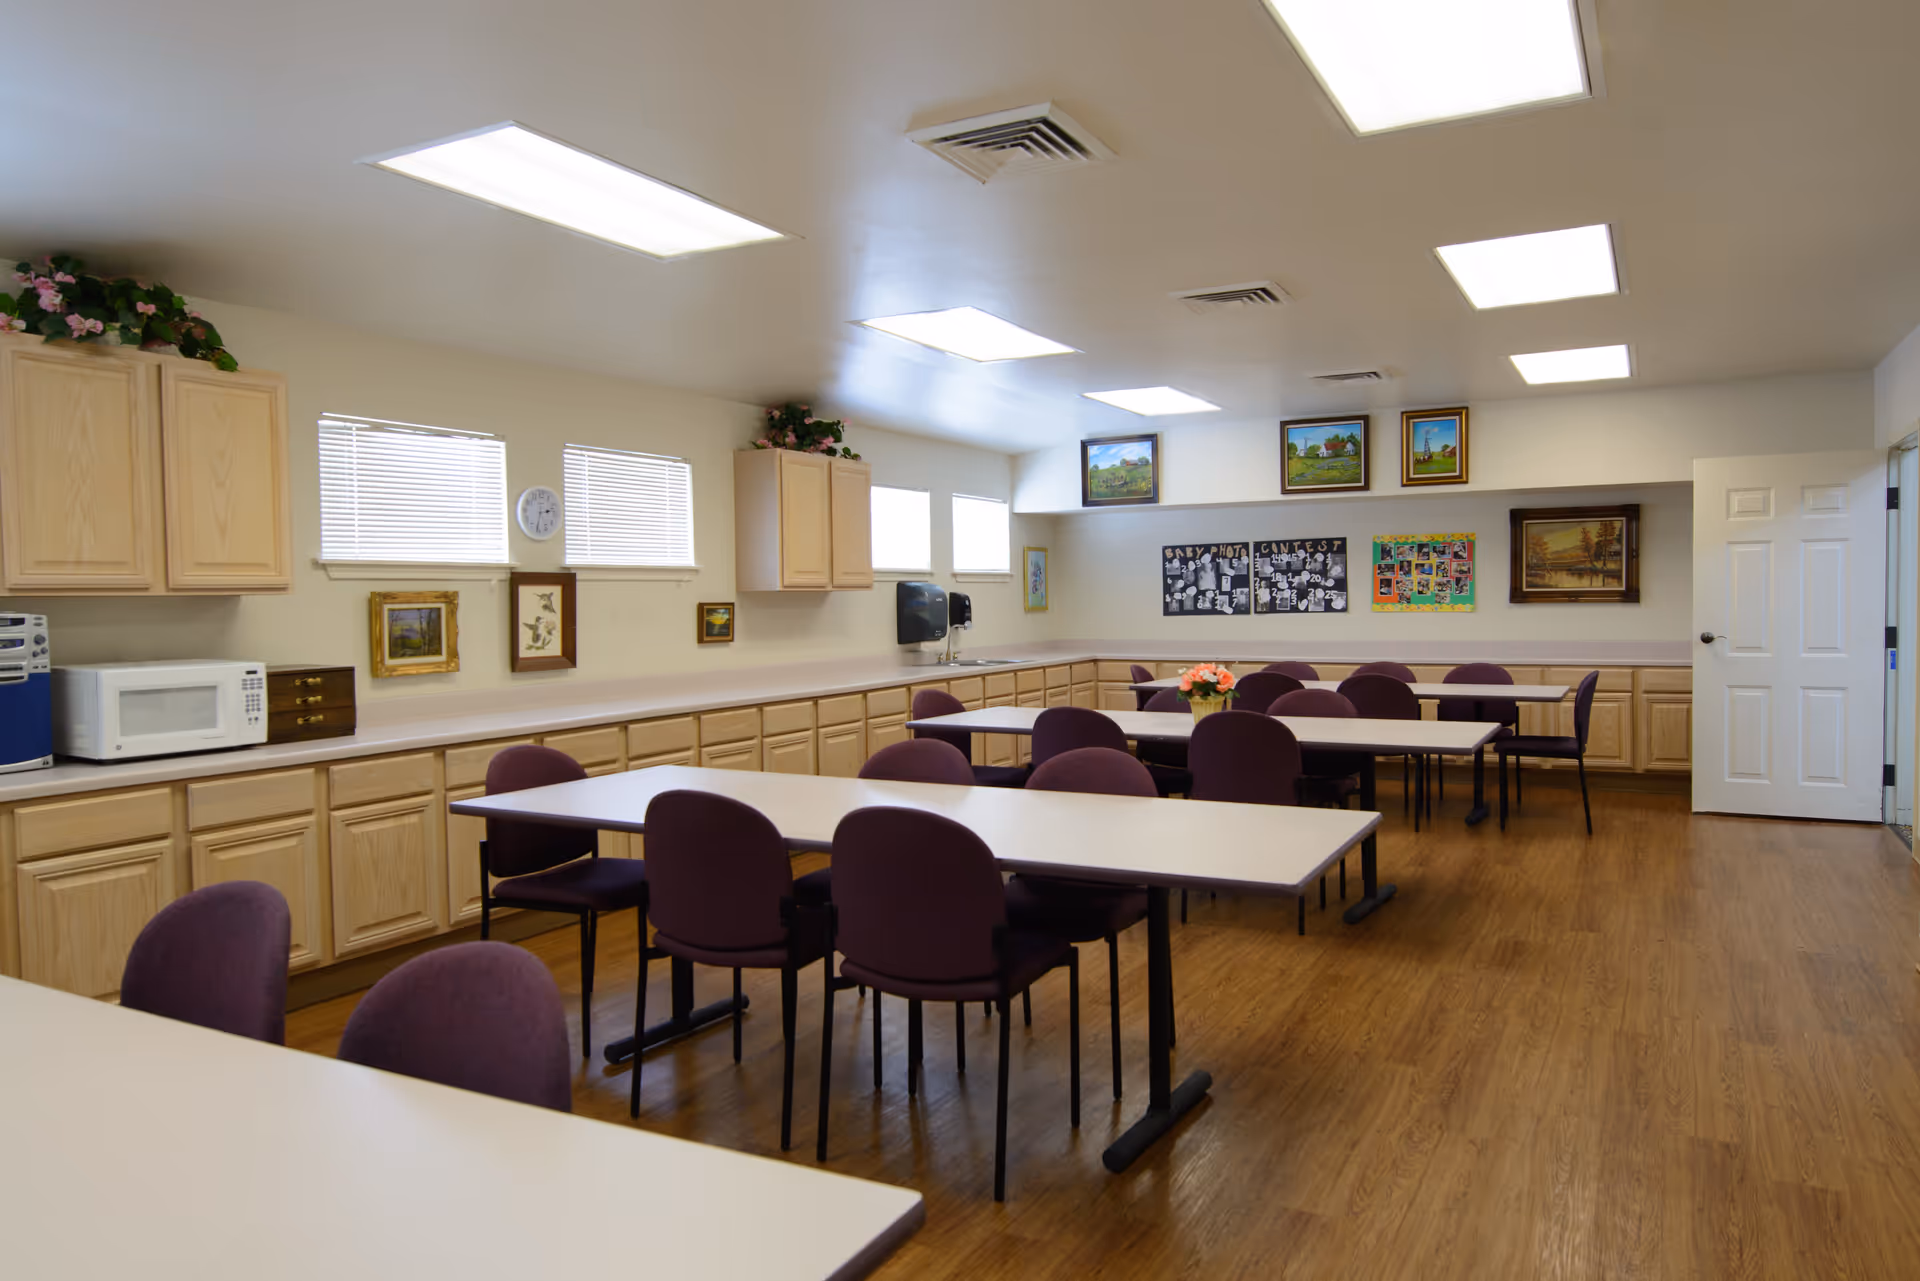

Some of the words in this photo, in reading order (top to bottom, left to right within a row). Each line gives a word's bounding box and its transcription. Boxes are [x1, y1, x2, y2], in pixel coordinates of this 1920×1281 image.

[1165, 547, 1204, 559] BABY
[1210, 545, 1247, 558] PHOTO
[1261, 541, 1341, 553] CONTEST
[1310, 574, 1321, 582] 20
